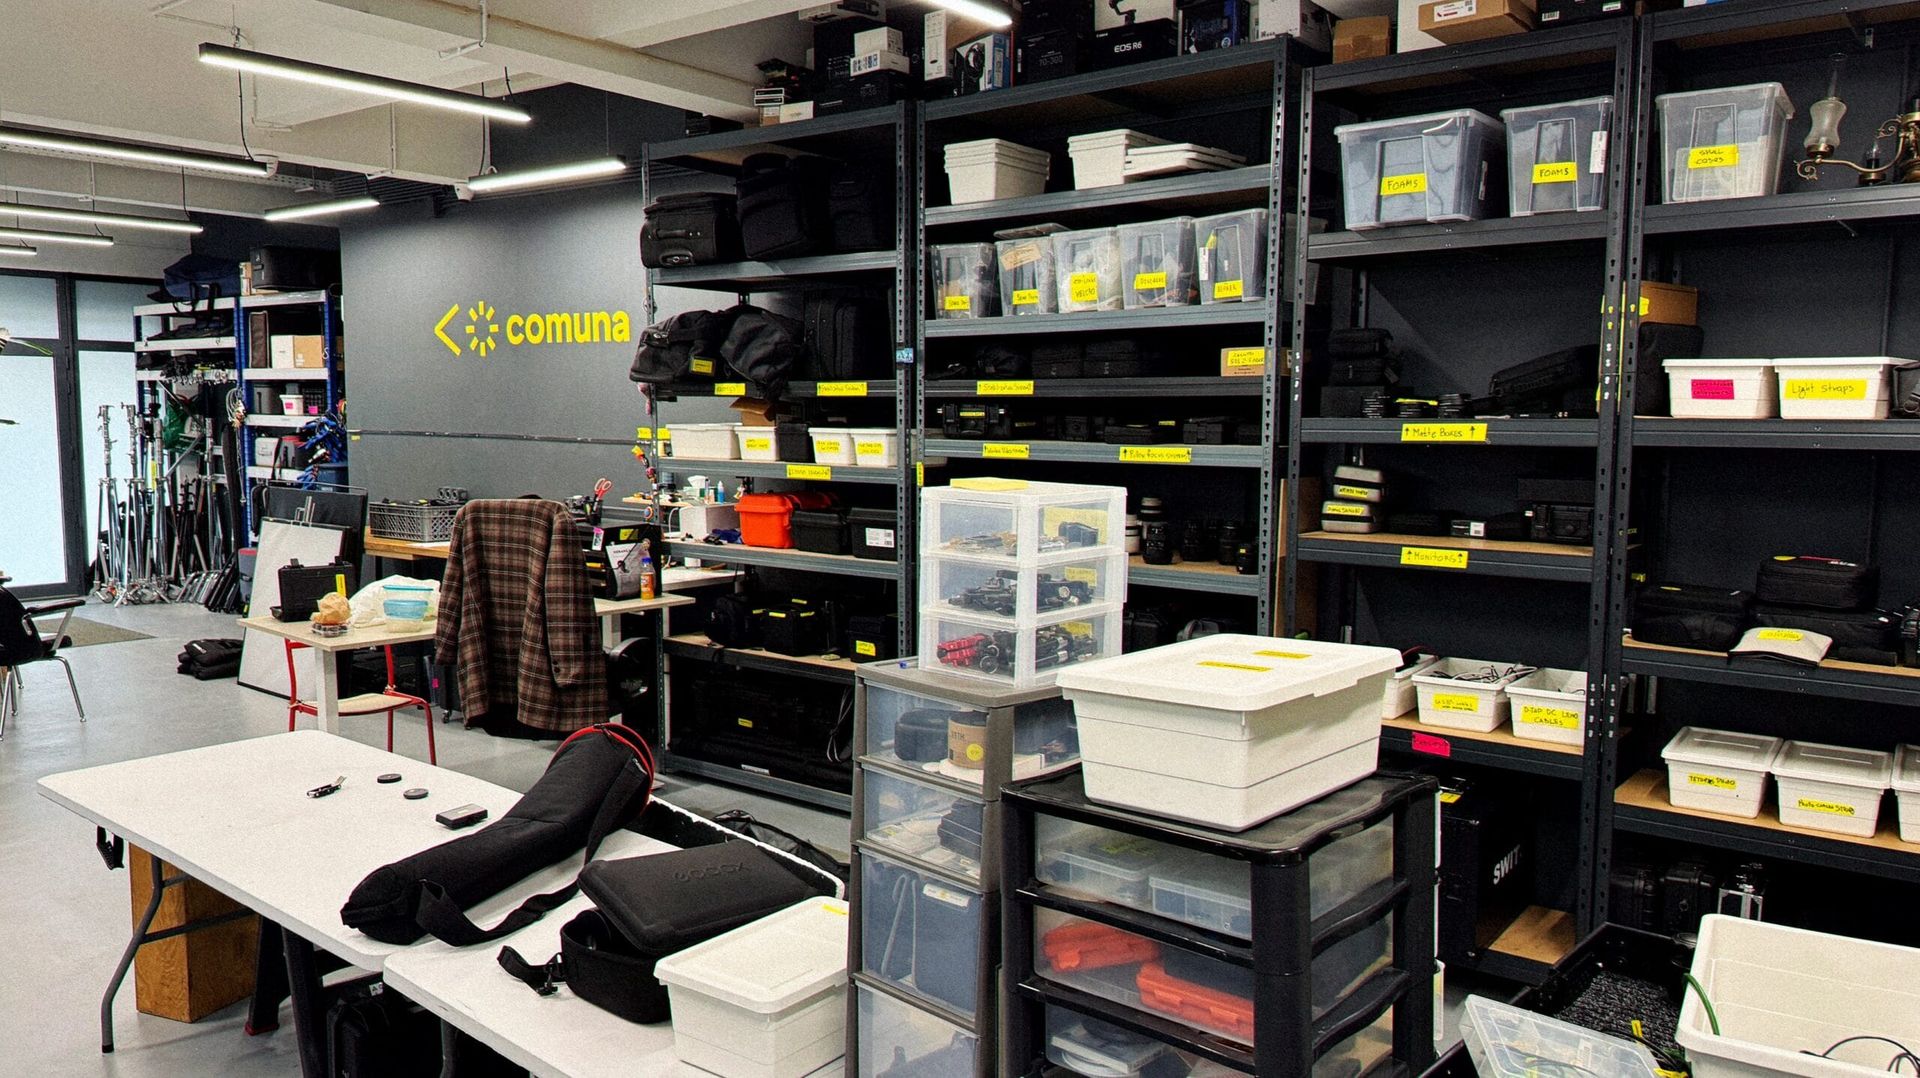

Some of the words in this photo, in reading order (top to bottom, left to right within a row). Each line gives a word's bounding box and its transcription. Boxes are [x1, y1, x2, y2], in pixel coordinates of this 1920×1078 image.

[1114, 43, 1132, 53] EOS
[1132, 41, 1143, 51] R6
[1539, 168, 1569, 177] FOAMS
[1387, 180, 1418, 190] FOAMS
[506, 310, 631, 345] comuna
[1791, 384, 1814, 399] Light
[1493, 844, 1521, 885] SWIT
